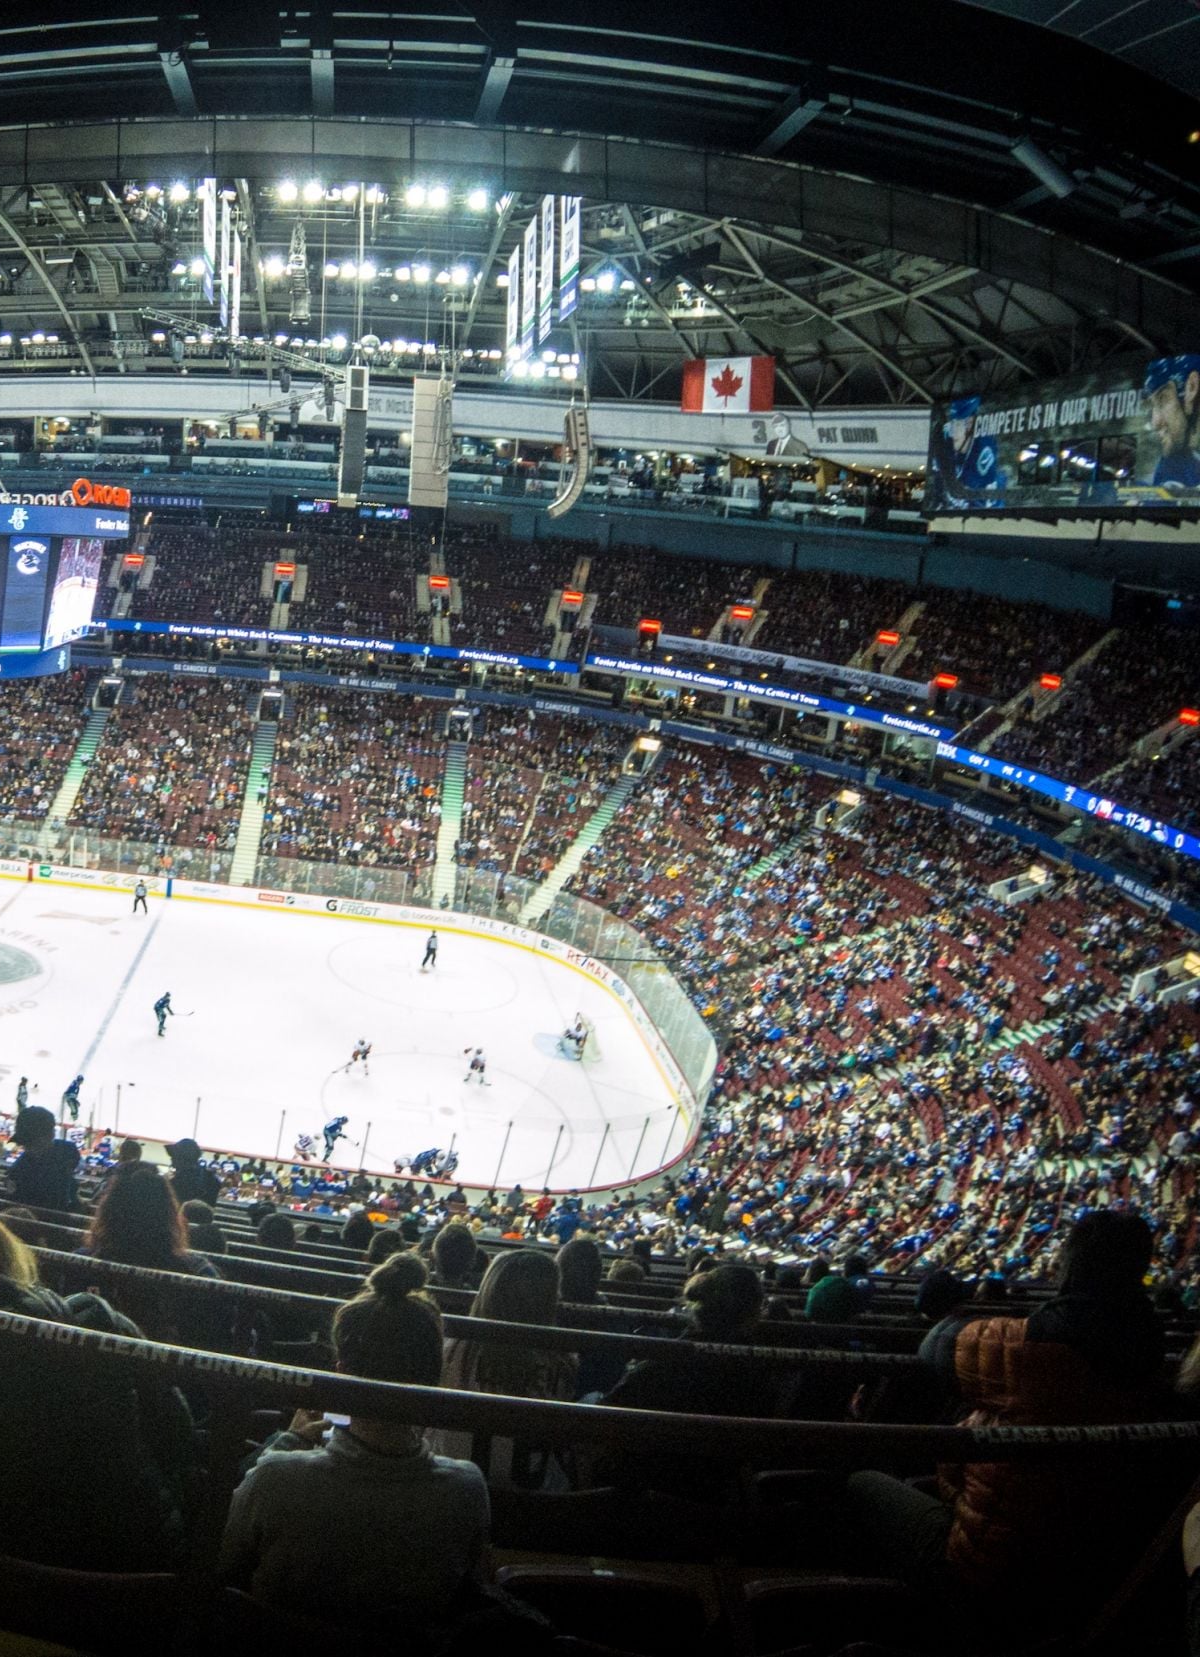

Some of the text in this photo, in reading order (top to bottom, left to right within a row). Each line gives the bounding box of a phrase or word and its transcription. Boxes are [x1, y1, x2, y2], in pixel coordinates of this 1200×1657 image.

[974, 407, 1027, 439] COMPETE
[1028, 404, 1042, 431] IS
[1043, 402, 1058, 429] IN
[1060, 397, 1088, 426] OUR
[752, 420, 767, 443] 3
[817, 427, 838, 443] PAT
[168, 624, 192, 633] Foster
[192, 626, 216, 635] Martin
[226, 629, 248, 638] White
[248, 630, 268, 640] Rock
[267, 632, 302, 643] Commons
[307, 635, 322, 644] The
[322, 636, 341, 645] New
[340, 638, 366, 648] Centre
[373, 642, 395, 651] Town
[459, 650, 520, 665] FosterMartin.ca
[339, 677, 397, 690] WE ARE ALL CANUCKS
[595, 657, 617, 668] Foster
[617, 660, 642, 671] Martin
[641, 665, 653, 673] on
[652, 666, 675, 677] White
[674, 670, 693, 680] Rock
[692, 673, 728, 688] Commons
[733, 681, 748, 691] The
[747, 683, 765, 695] New
[765, 687, 790, 699] Centre
[790, 692, 800, 701] of
[799, 694, 820, 706] Town
[882, 714, 941, 738] FosterMartin.ca
[736, 739, 794, 761] WE ARE ALL CANUCKS
[326, 899, 382, 917] G FROST
[471, 917, 528, 939] THE KEG
[567, 950, 609, 980] RE/MAX
[34, 1318, 95, 1349] NOT
[101, 1334, 174, 1368] LEAN
[175, 1346, 315, 1390] FORWARD
[974, 1426, 1051, 1444] PLEASE
